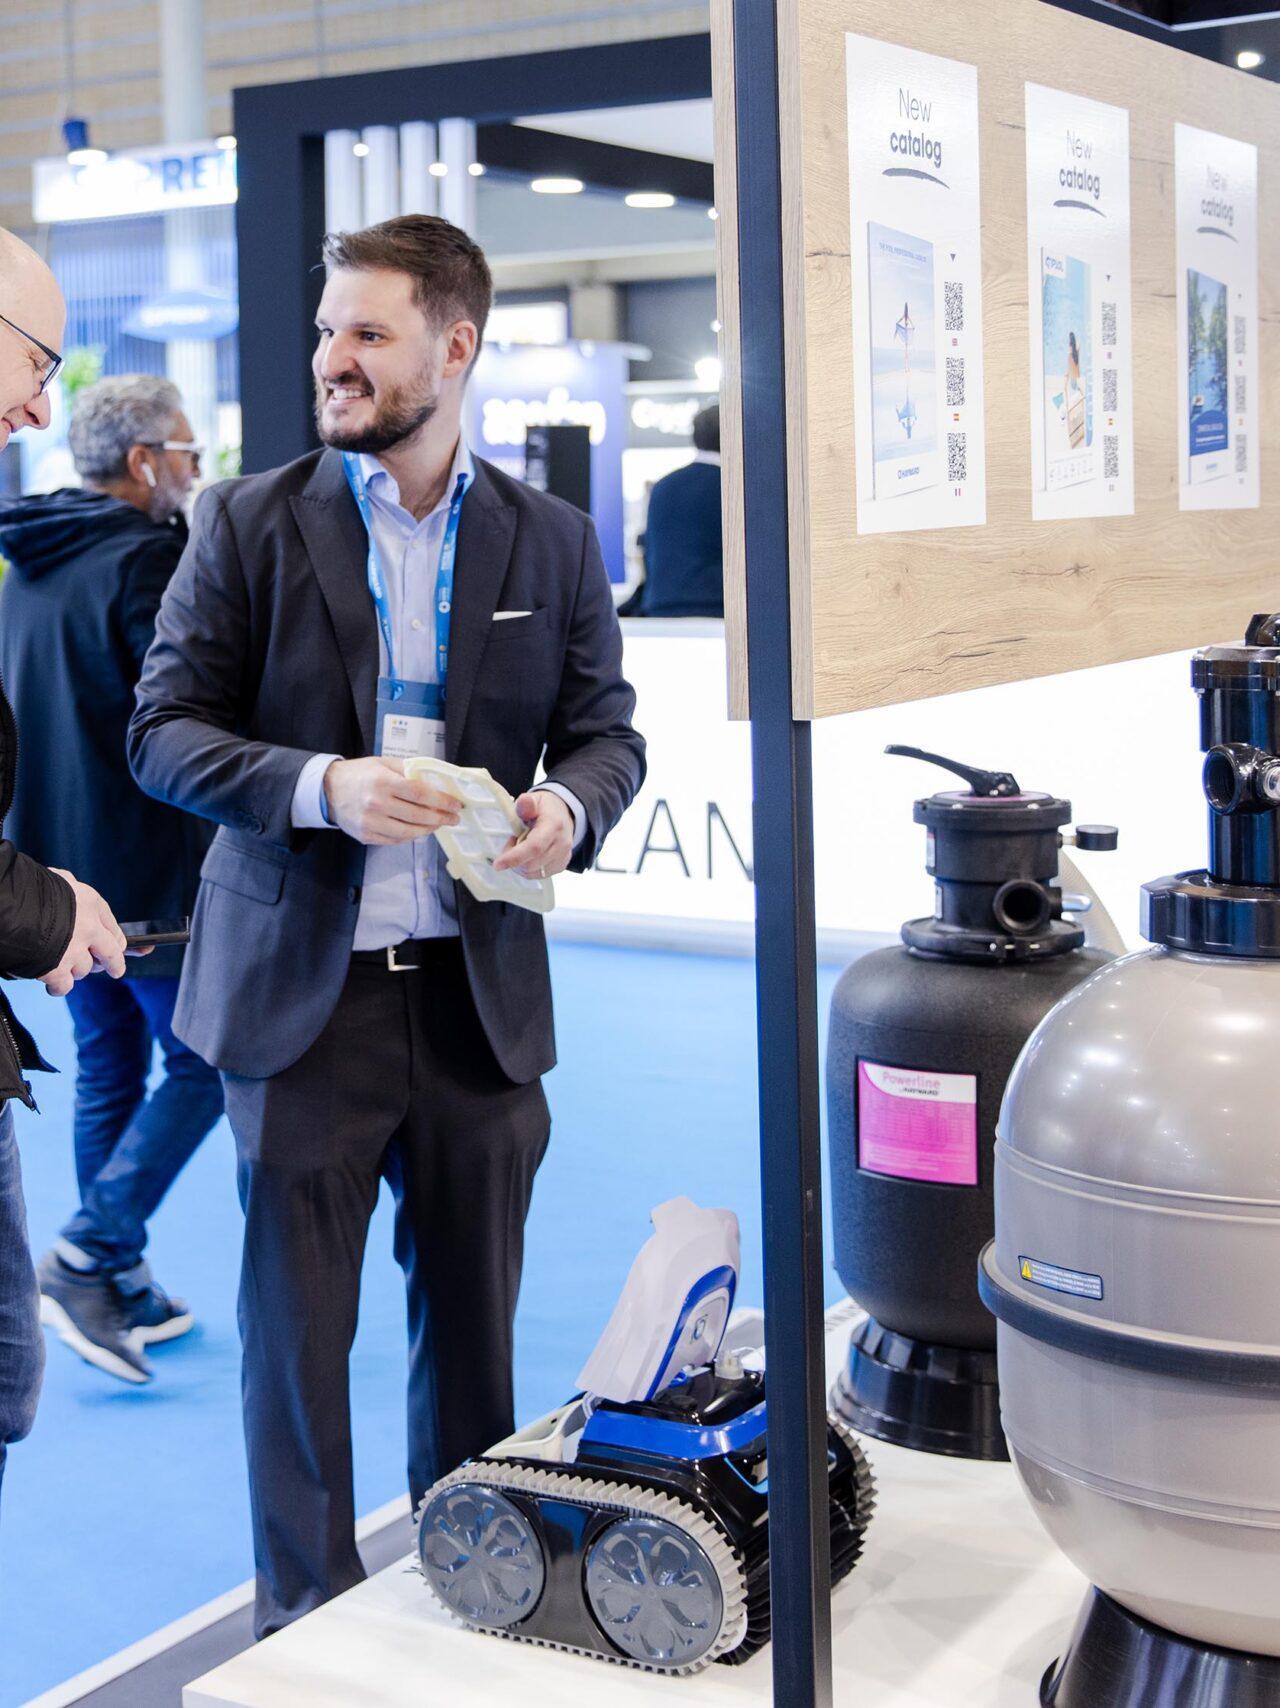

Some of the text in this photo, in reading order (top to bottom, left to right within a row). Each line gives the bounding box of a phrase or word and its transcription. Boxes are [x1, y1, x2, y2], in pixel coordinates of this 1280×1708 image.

[899, 87, 932, 122] New
[890, 129, 942, 168] catalog
[1066, 129, 1093, 159] New
[1059, 166, 1100, 200] catalog
[594, 799, 754, 881] AN
[883, 1072, 941, 1089] Powerline
